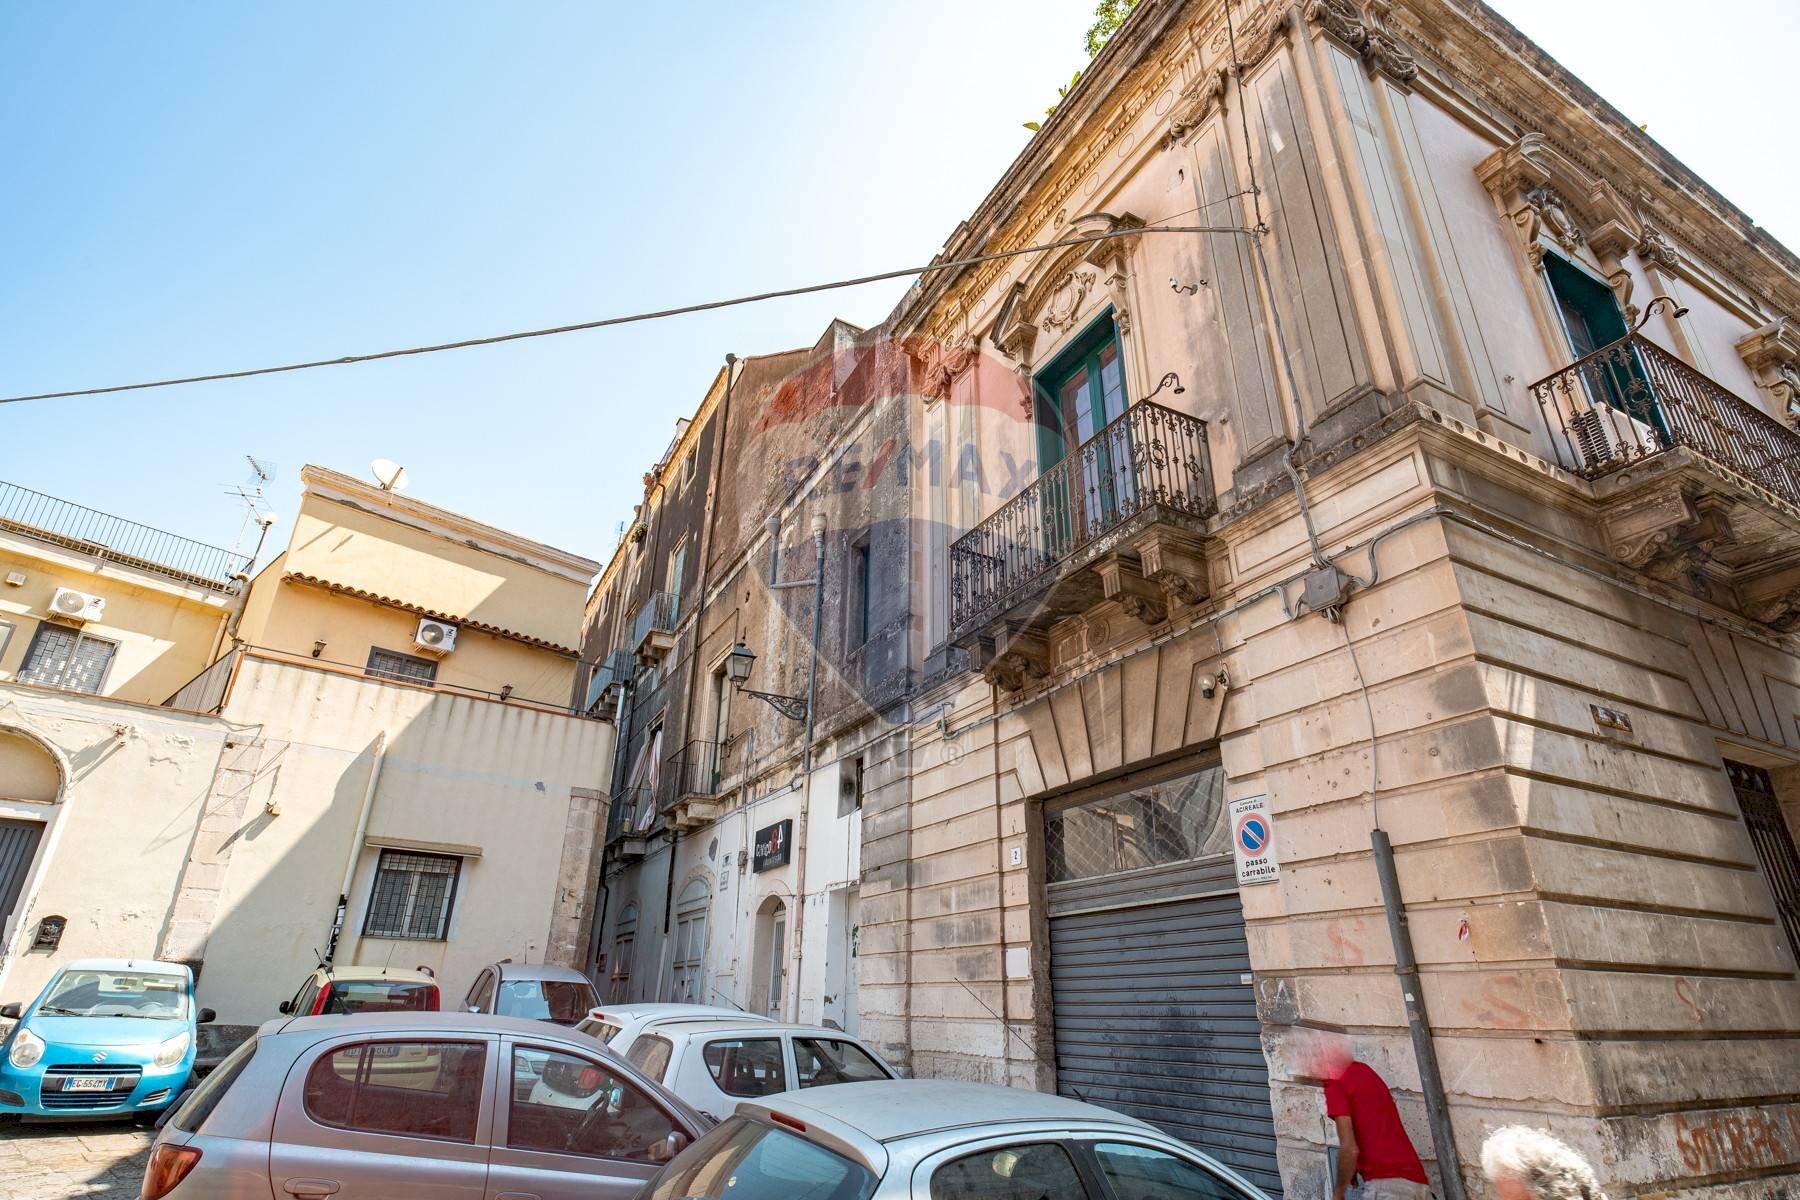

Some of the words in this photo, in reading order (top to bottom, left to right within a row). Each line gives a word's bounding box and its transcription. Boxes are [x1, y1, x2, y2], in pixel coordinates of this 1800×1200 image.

[1235, 803, 1264, 814] ACIREALE
[1245, 858, 1268, 867] passo
[1241, 866, 1276, 877] carrabile
